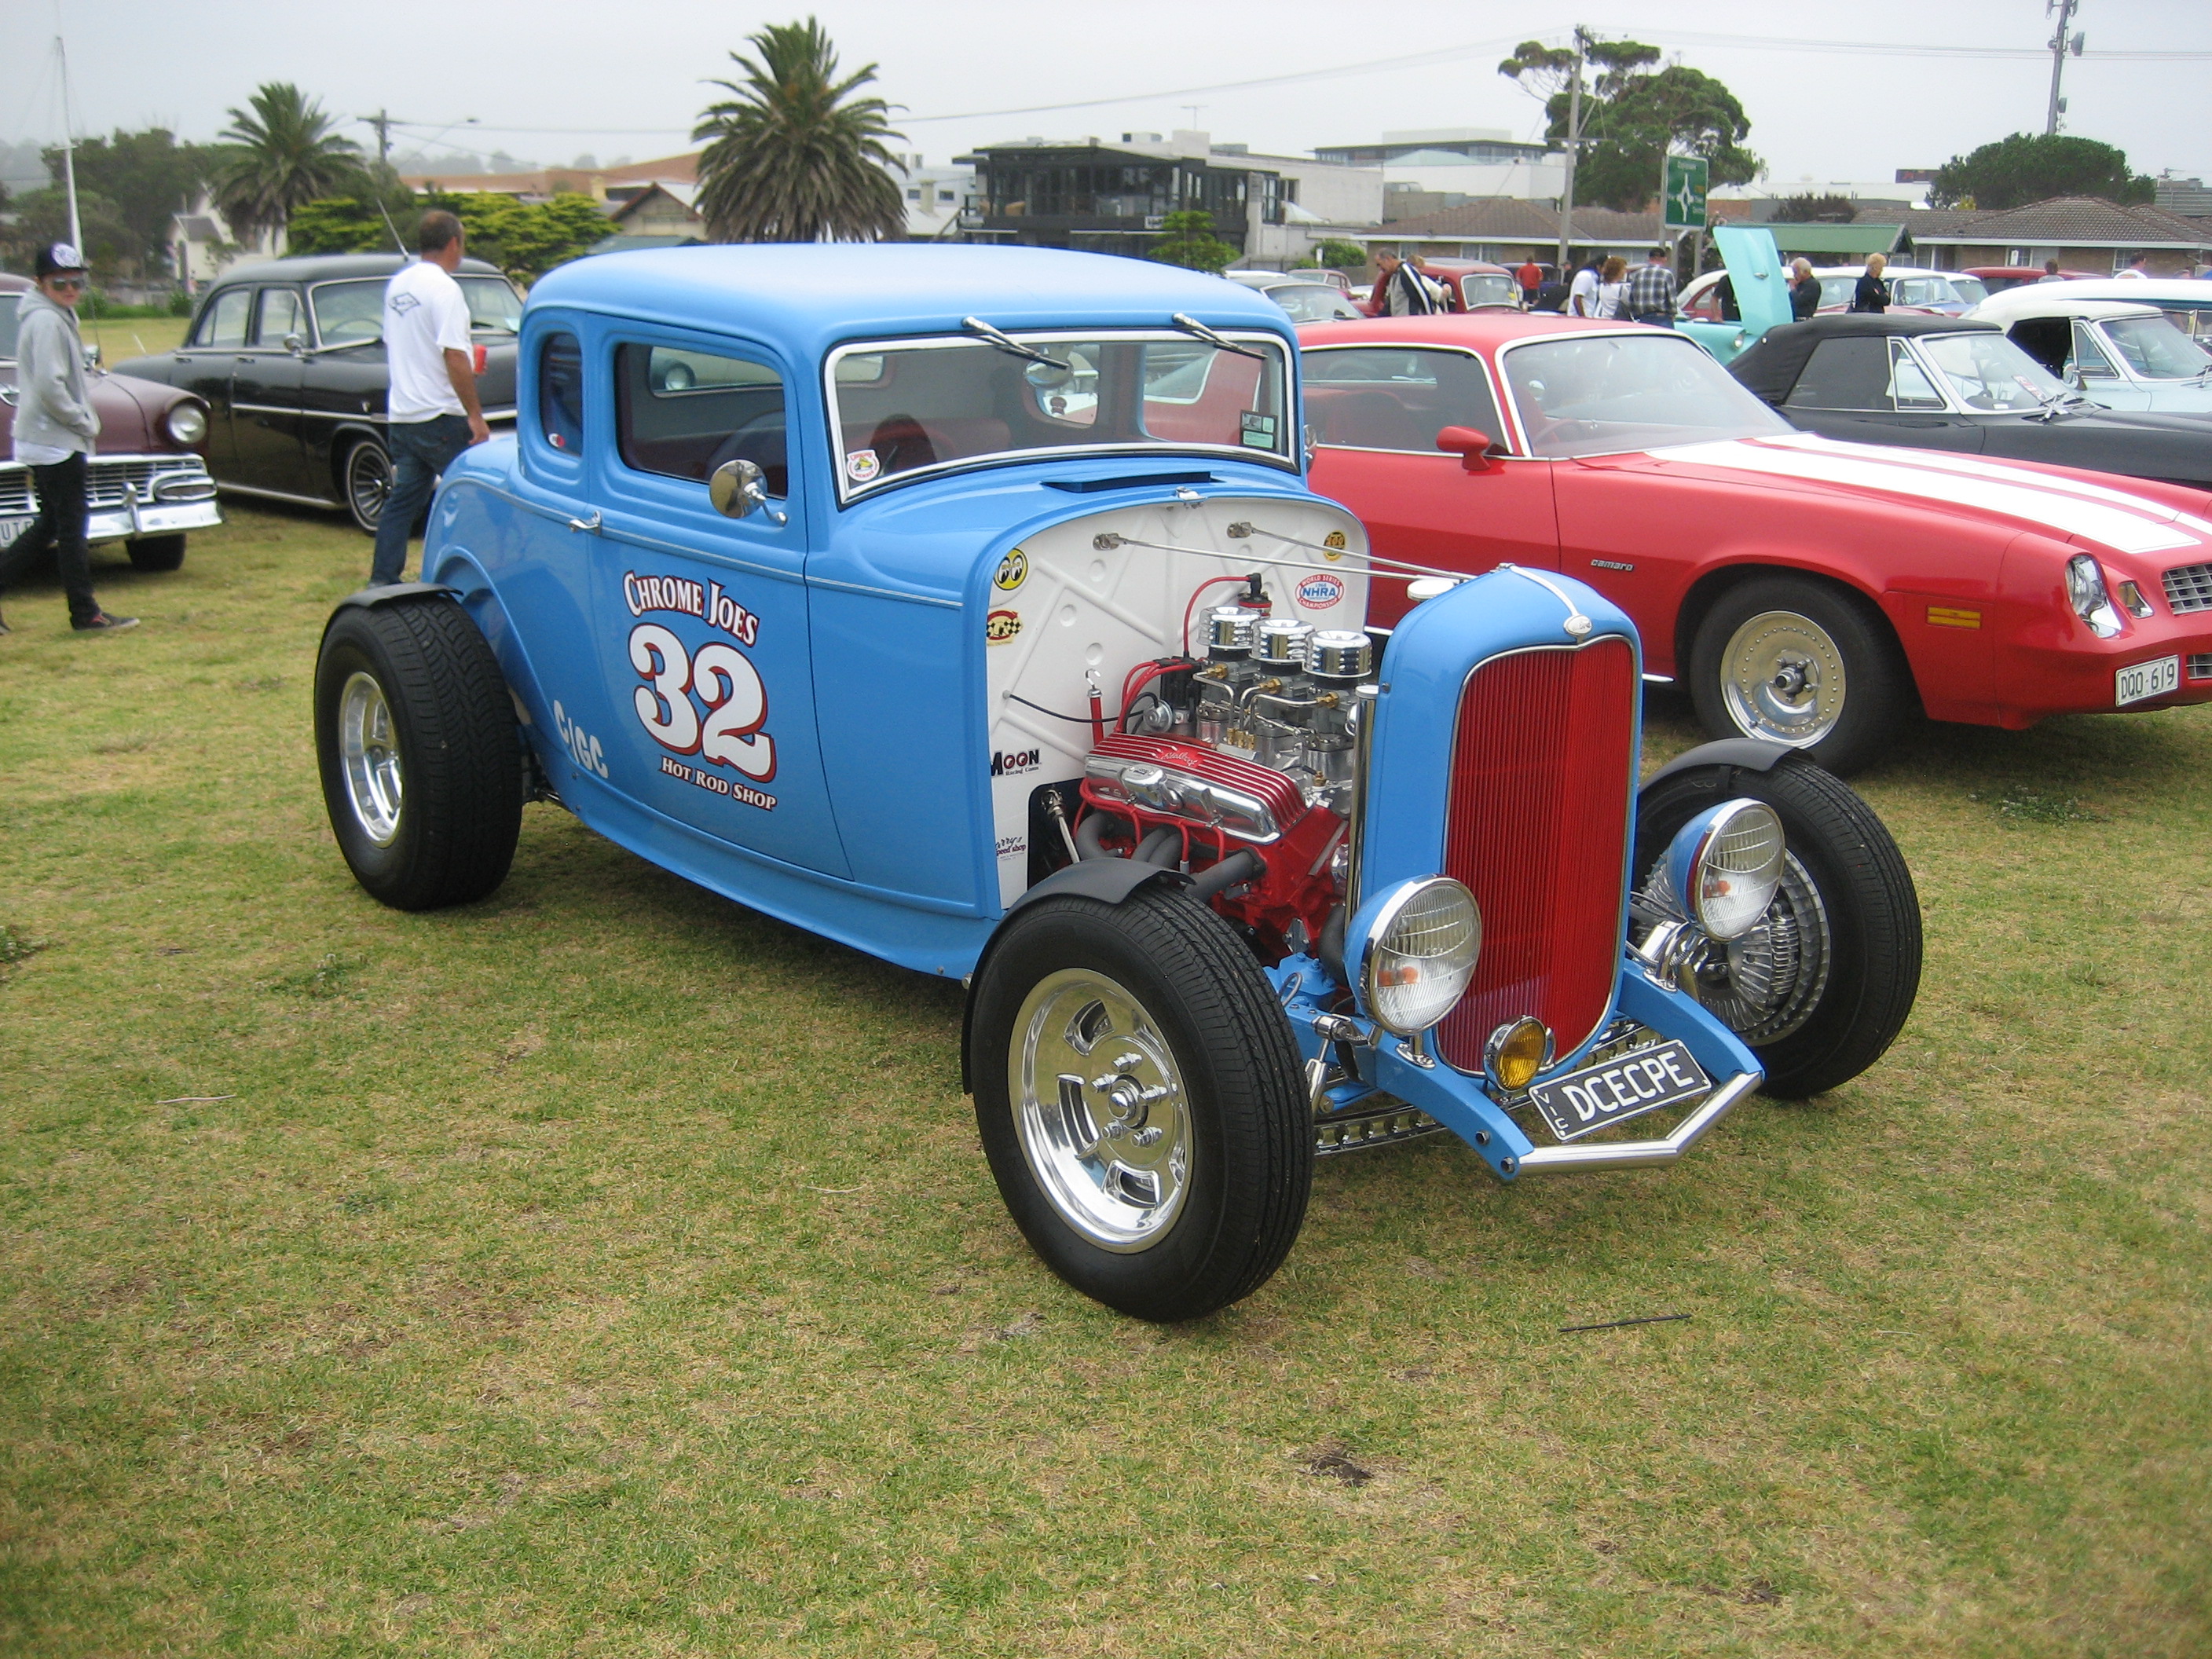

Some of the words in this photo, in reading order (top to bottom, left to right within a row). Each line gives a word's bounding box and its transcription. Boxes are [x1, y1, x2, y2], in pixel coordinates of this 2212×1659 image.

[1302, 575, 1321, 586] WORLD
[1322, 575, 1340, 586] SERIES
[1591, 558, 1634, 571] camaro
[623, 571, 705, 617] CHROME
[709, 577, 760, 647] JOES
[1298, 597, 1338, 609] CHAMPIONSHIP
[1302, 588, 1336, 597] NHRA
[628, 622, 777, 784] 32
[990, 749, 1040, 777] MOON
[661, 755, 692, 783] HOT
[695, 767, 729, 796] ROD
[732, 782, 777, 811] SHOP
[1561, 1050, 1695, 1122] DCECPE
[1537, 1092, 1569, 1130] VIC
